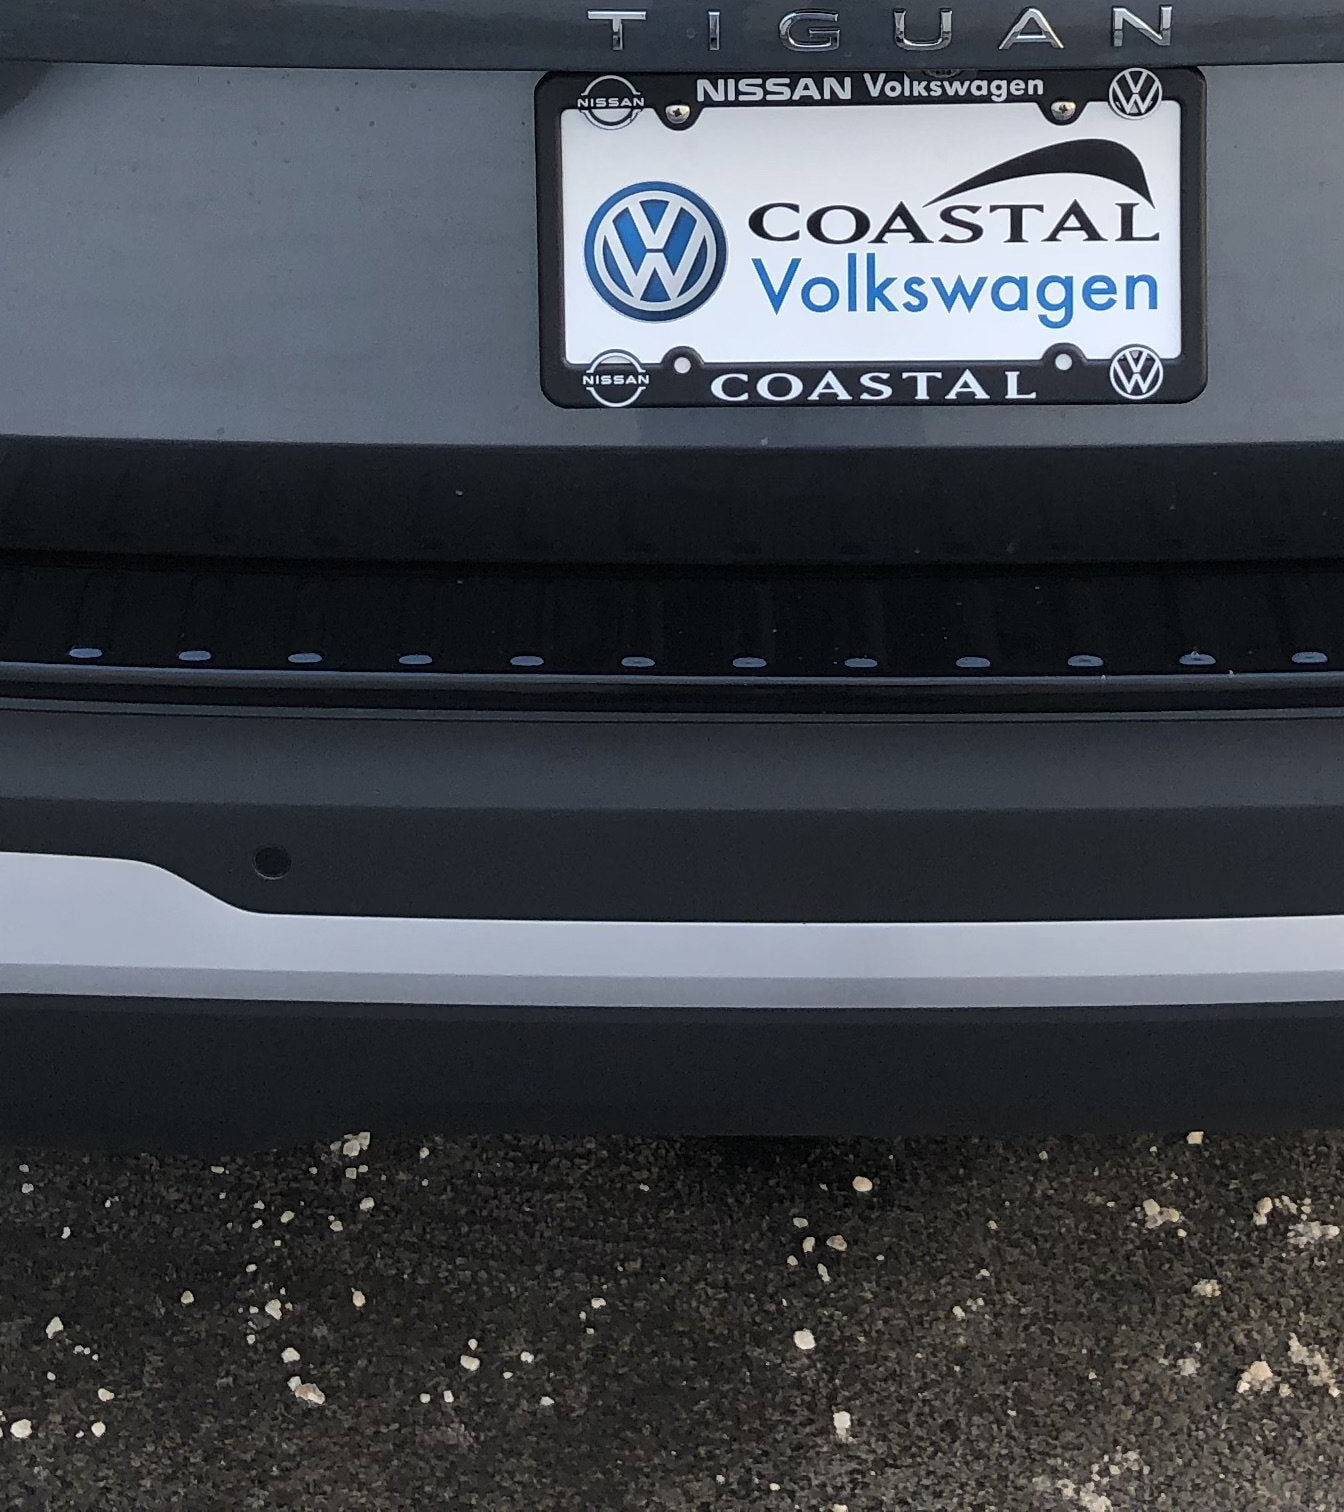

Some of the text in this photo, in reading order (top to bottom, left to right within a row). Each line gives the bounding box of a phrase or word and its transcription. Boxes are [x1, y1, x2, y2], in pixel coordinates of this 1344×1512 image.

[587, 4, 1173, 52] TIGUAN
[577, 96, 645, 108] NISSAN
[696, 72, 1045, 102] NISSAN Volkswagen
[748, 202, 1160, 245] COASTAL
[751, 252, 1159, 330] Volkswagen
[582, 374, 650, 386] NISSAN
[710, 370, 1037, 402] COASTAL
